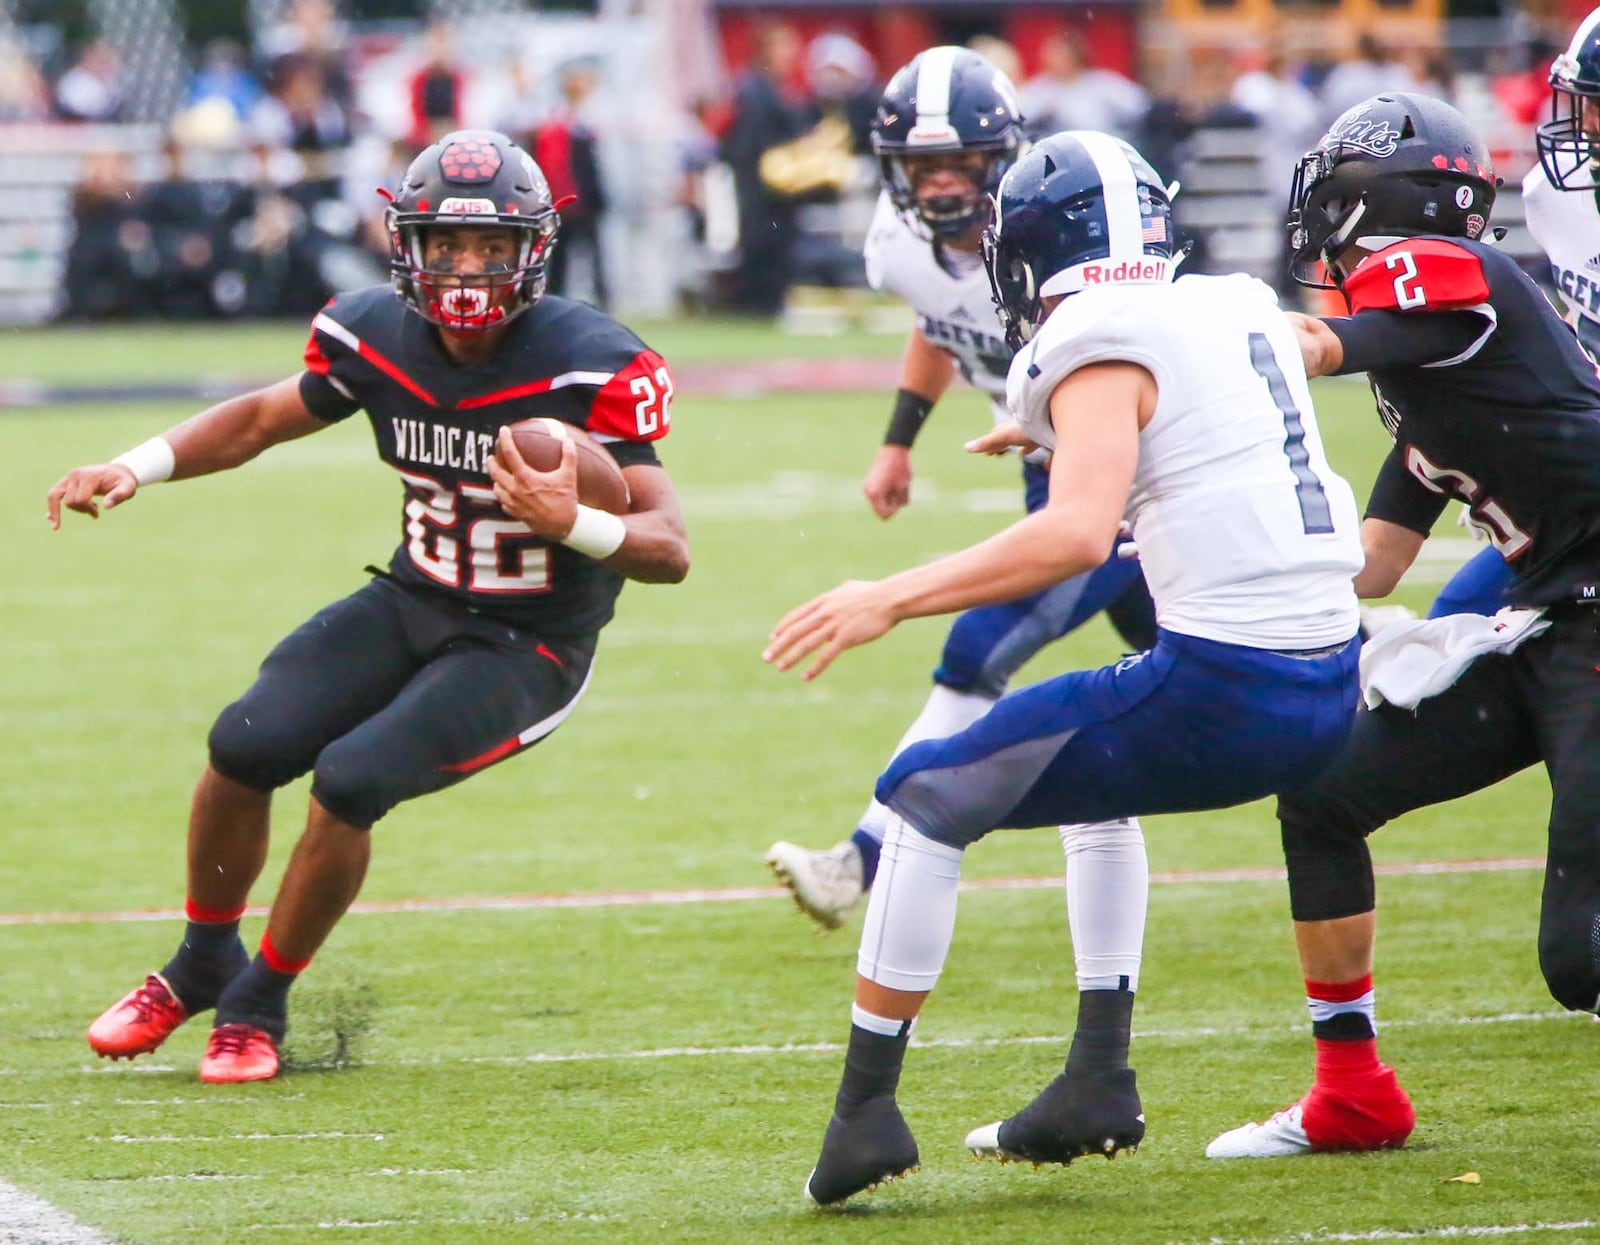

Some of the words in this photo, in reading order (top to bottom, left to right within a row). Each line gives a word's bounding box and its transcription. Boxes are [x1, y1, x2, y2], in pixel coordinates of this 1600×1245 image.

[1318, 103, 1400, 158] Cats
[1461, 189, 1469, 206] 2
[1083, 261, 1165, 284] Riddell
[1385, 251, 1427, 311] 2
[629, 366, 674, 436] 22
[392, 417, 498, 474] WILDCAT
[1248, 332, 1336, 535] 1
[399, 471, 551, 595] 22
